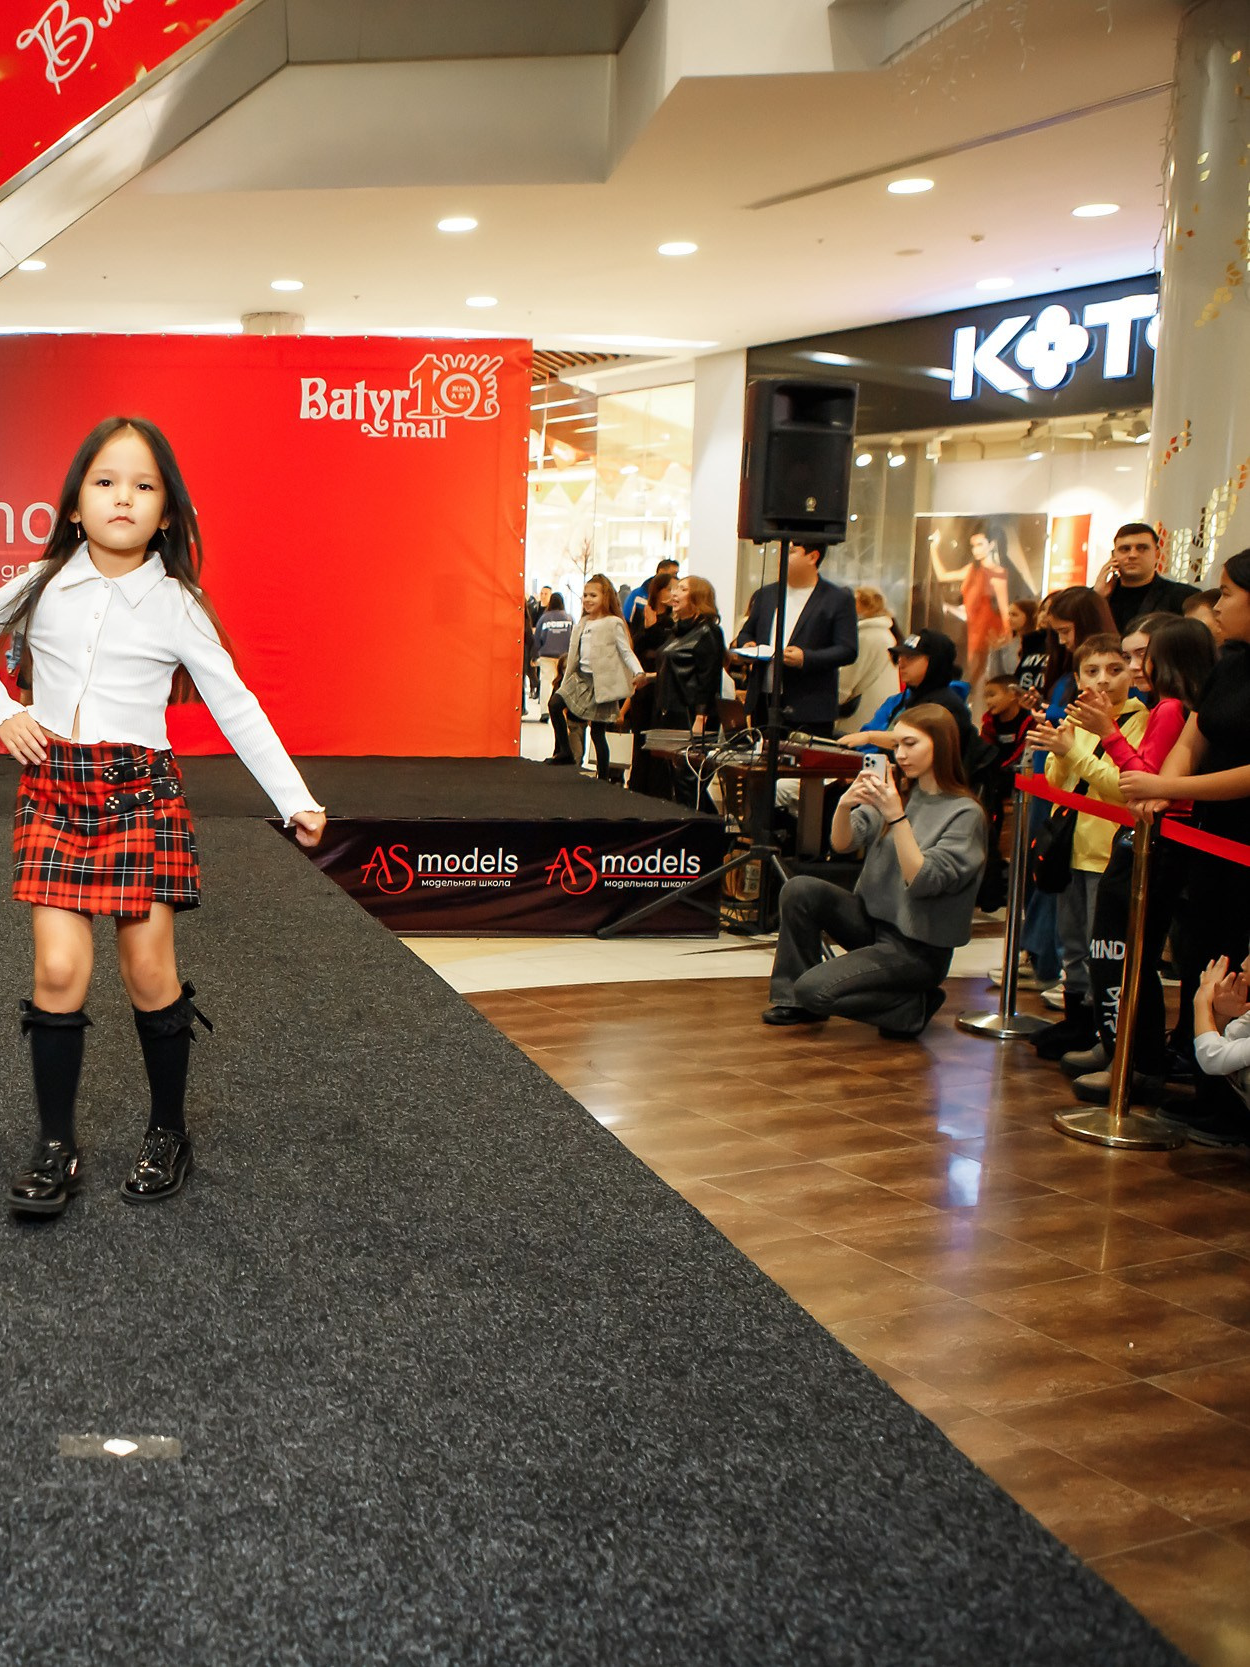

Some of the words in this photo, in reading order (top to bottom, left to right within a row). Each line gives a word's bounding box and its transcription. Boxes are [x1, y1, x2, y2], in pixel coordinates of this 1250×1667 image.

[950, 293, 1158, 400] KOT
[300, 377, 411, 437] Batyr
[393, 419, 446, 438] mall
[360, 843, 414, 895] AS
[417, 847, 519, 874] models
[478, 880, 511, 888] школа
[544, 845, 598, 895] AS
[601, 848, 701, 874] models
